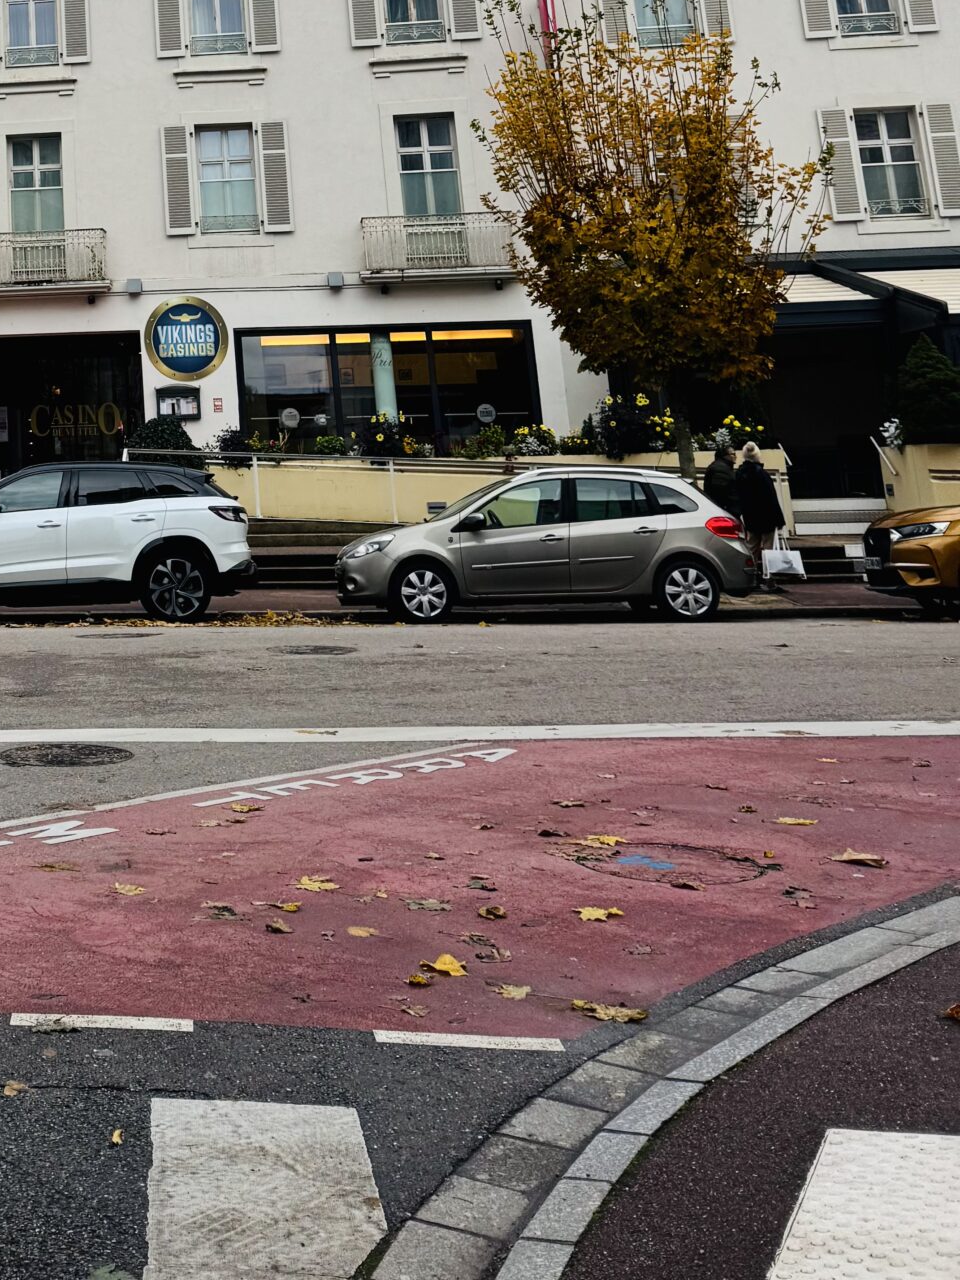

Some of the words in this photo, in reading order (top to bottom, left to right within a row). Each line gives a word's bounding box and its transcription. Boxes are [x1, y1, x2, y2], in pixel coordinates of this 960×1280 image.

[157, 324, 215, 344] VIKINGS
[159, 344, 216, 358] CASINOS
[30, 402, 120, 437] CASINO
[192, 747, 517, 808] ARRET
